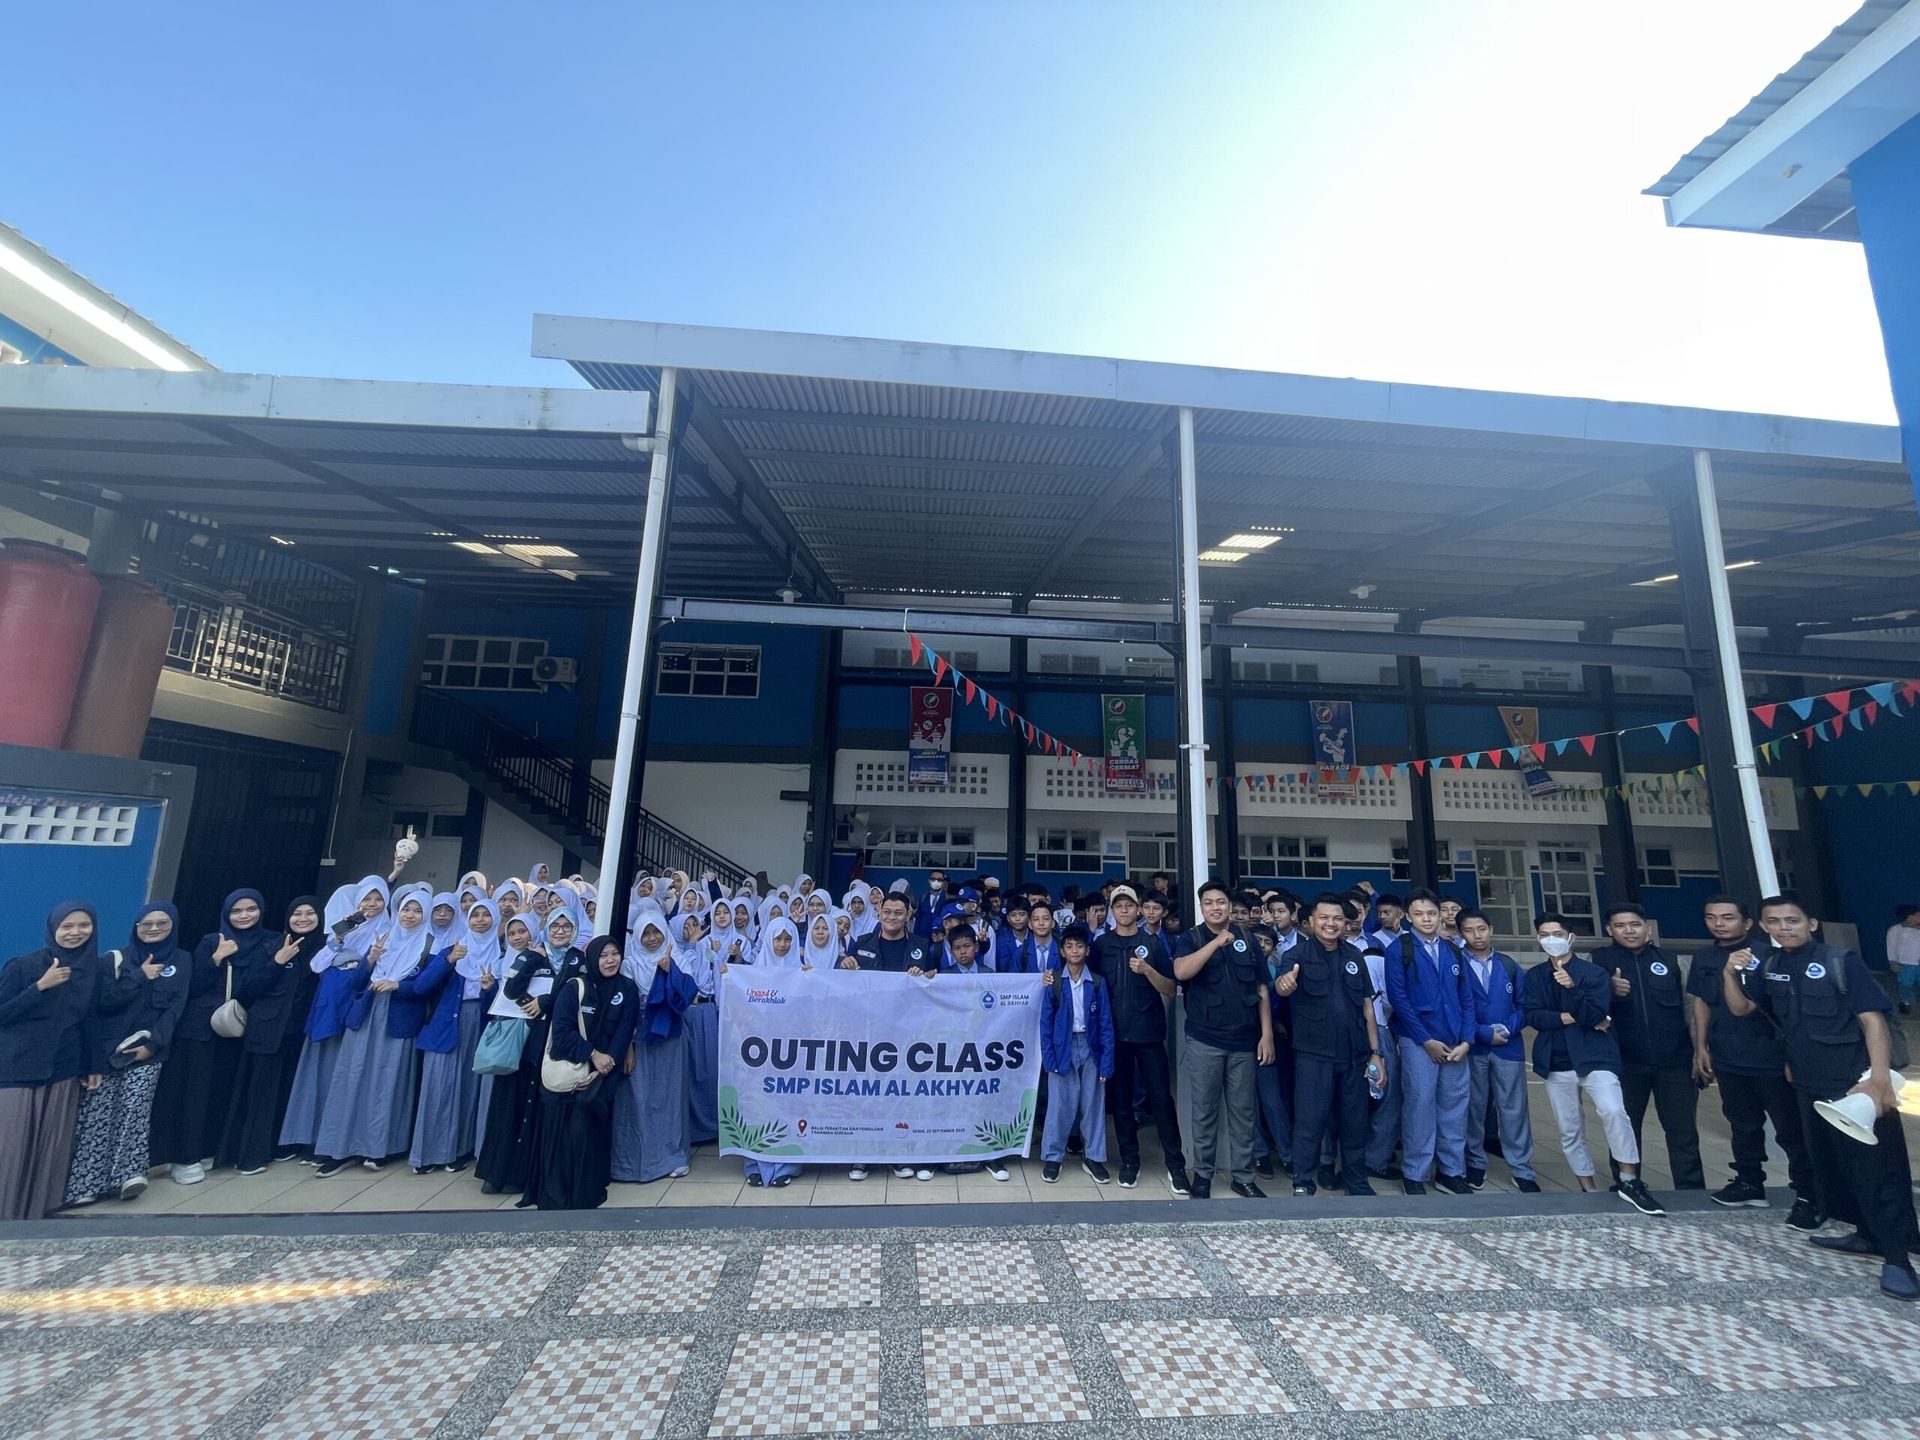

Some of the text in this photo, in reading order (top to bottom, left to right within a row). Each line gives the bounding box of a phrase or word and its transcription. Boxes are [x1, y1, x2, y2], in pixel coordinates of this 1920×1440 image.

[748, 995, 786, 1004] Berakhlak
[740, 1036, 1025, 1073] OUTING CLASS
[763, 1076, 1000, 1097] SMP ISLAM AL AKHYAR
